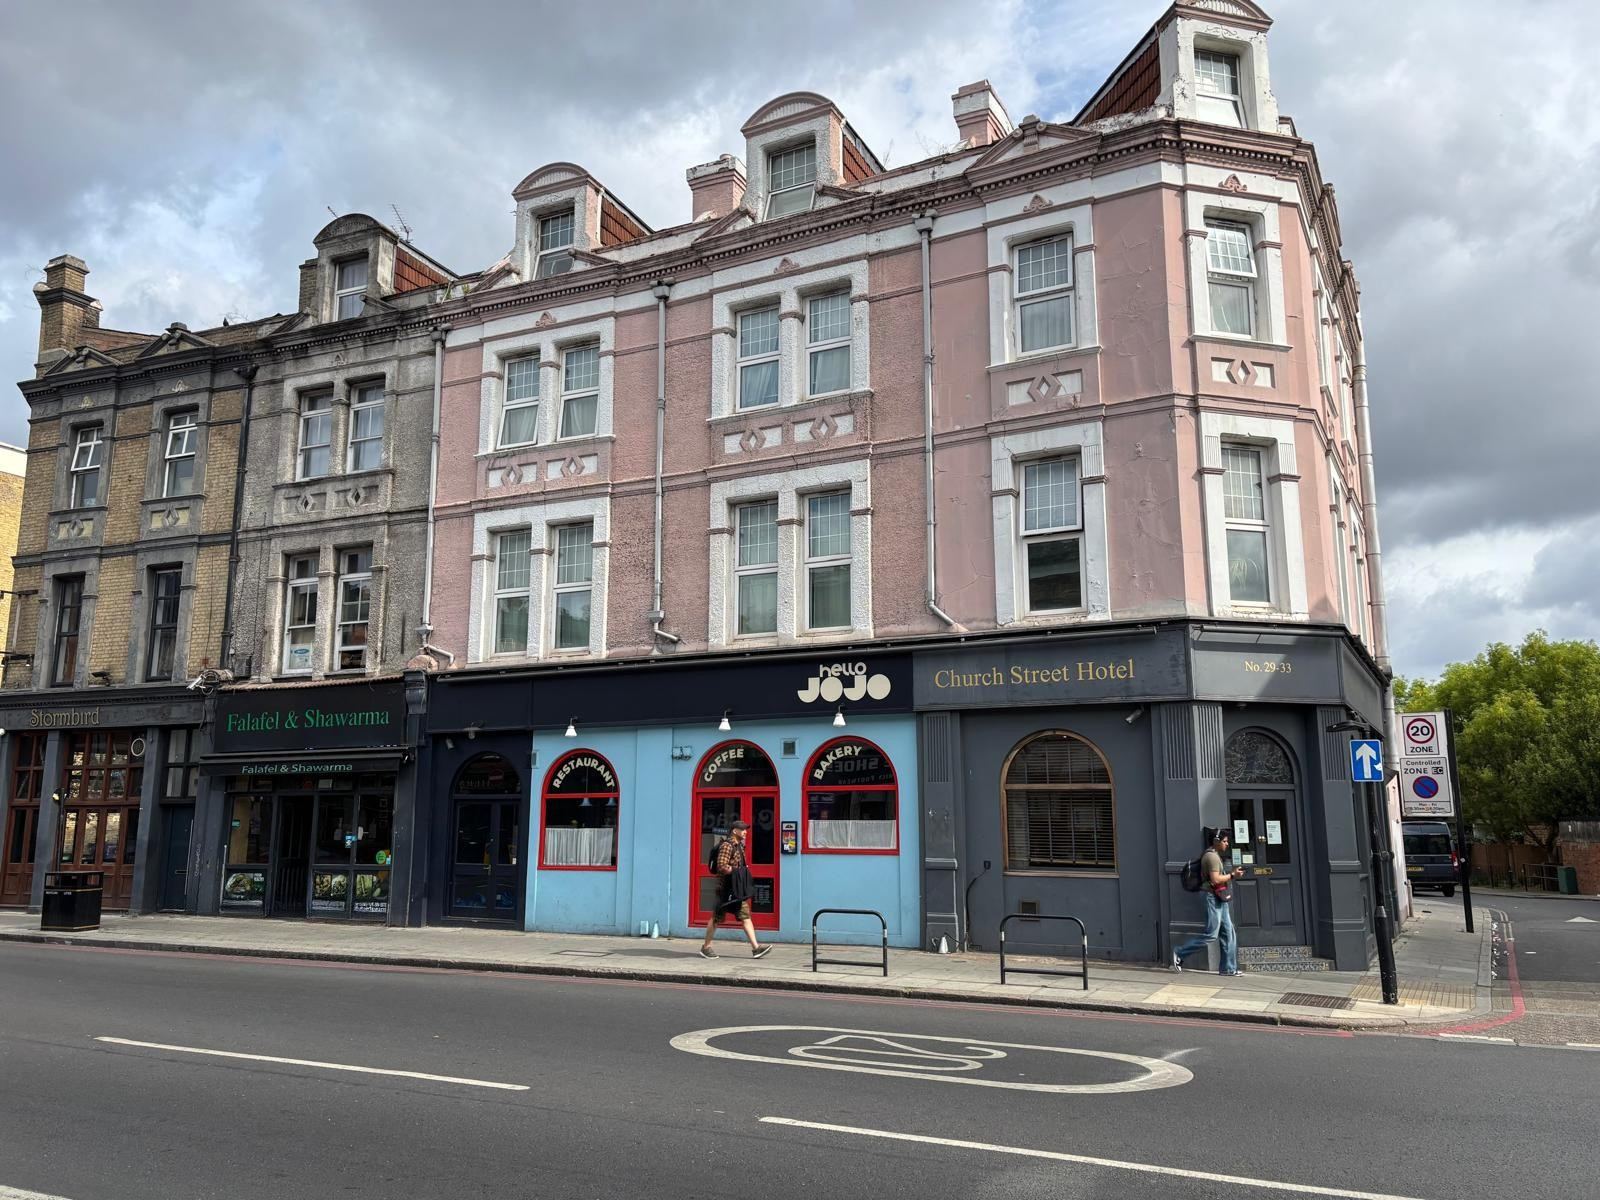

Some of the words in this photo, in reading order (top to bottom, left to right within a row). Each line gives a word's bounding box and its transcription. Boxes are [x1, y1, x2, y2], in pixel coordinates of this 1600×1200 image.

[820, 661, 867, 678] hello
[934, 667, 1004, 689] Church
[1010, 664, 1069, 685] Street
[1076, 659, 1135, 681] Hotel
[1244, 660, 1262, 672] No.
[1264, 661, 1292, 674] 29-33
[29, 706, 101, 728] Stormbird
[226, 711, 280, 732] Falafel
[284, 710, 299, 729] &
[304, 707, 390, 729] Shawarma
[1410, 725, 1430, 736] 20
[241, 764, 278, 774] Falafel
[280, 764, 289, 773] &
[291, 762, 353, 773] Shawarma
[552, 756, 616, 790] RESTAURANT
[703, 748, 745, 783] COFFEE
[813, 745, 863, 780] BAKERY
[1403, 767, 1429, 775] ZONE
